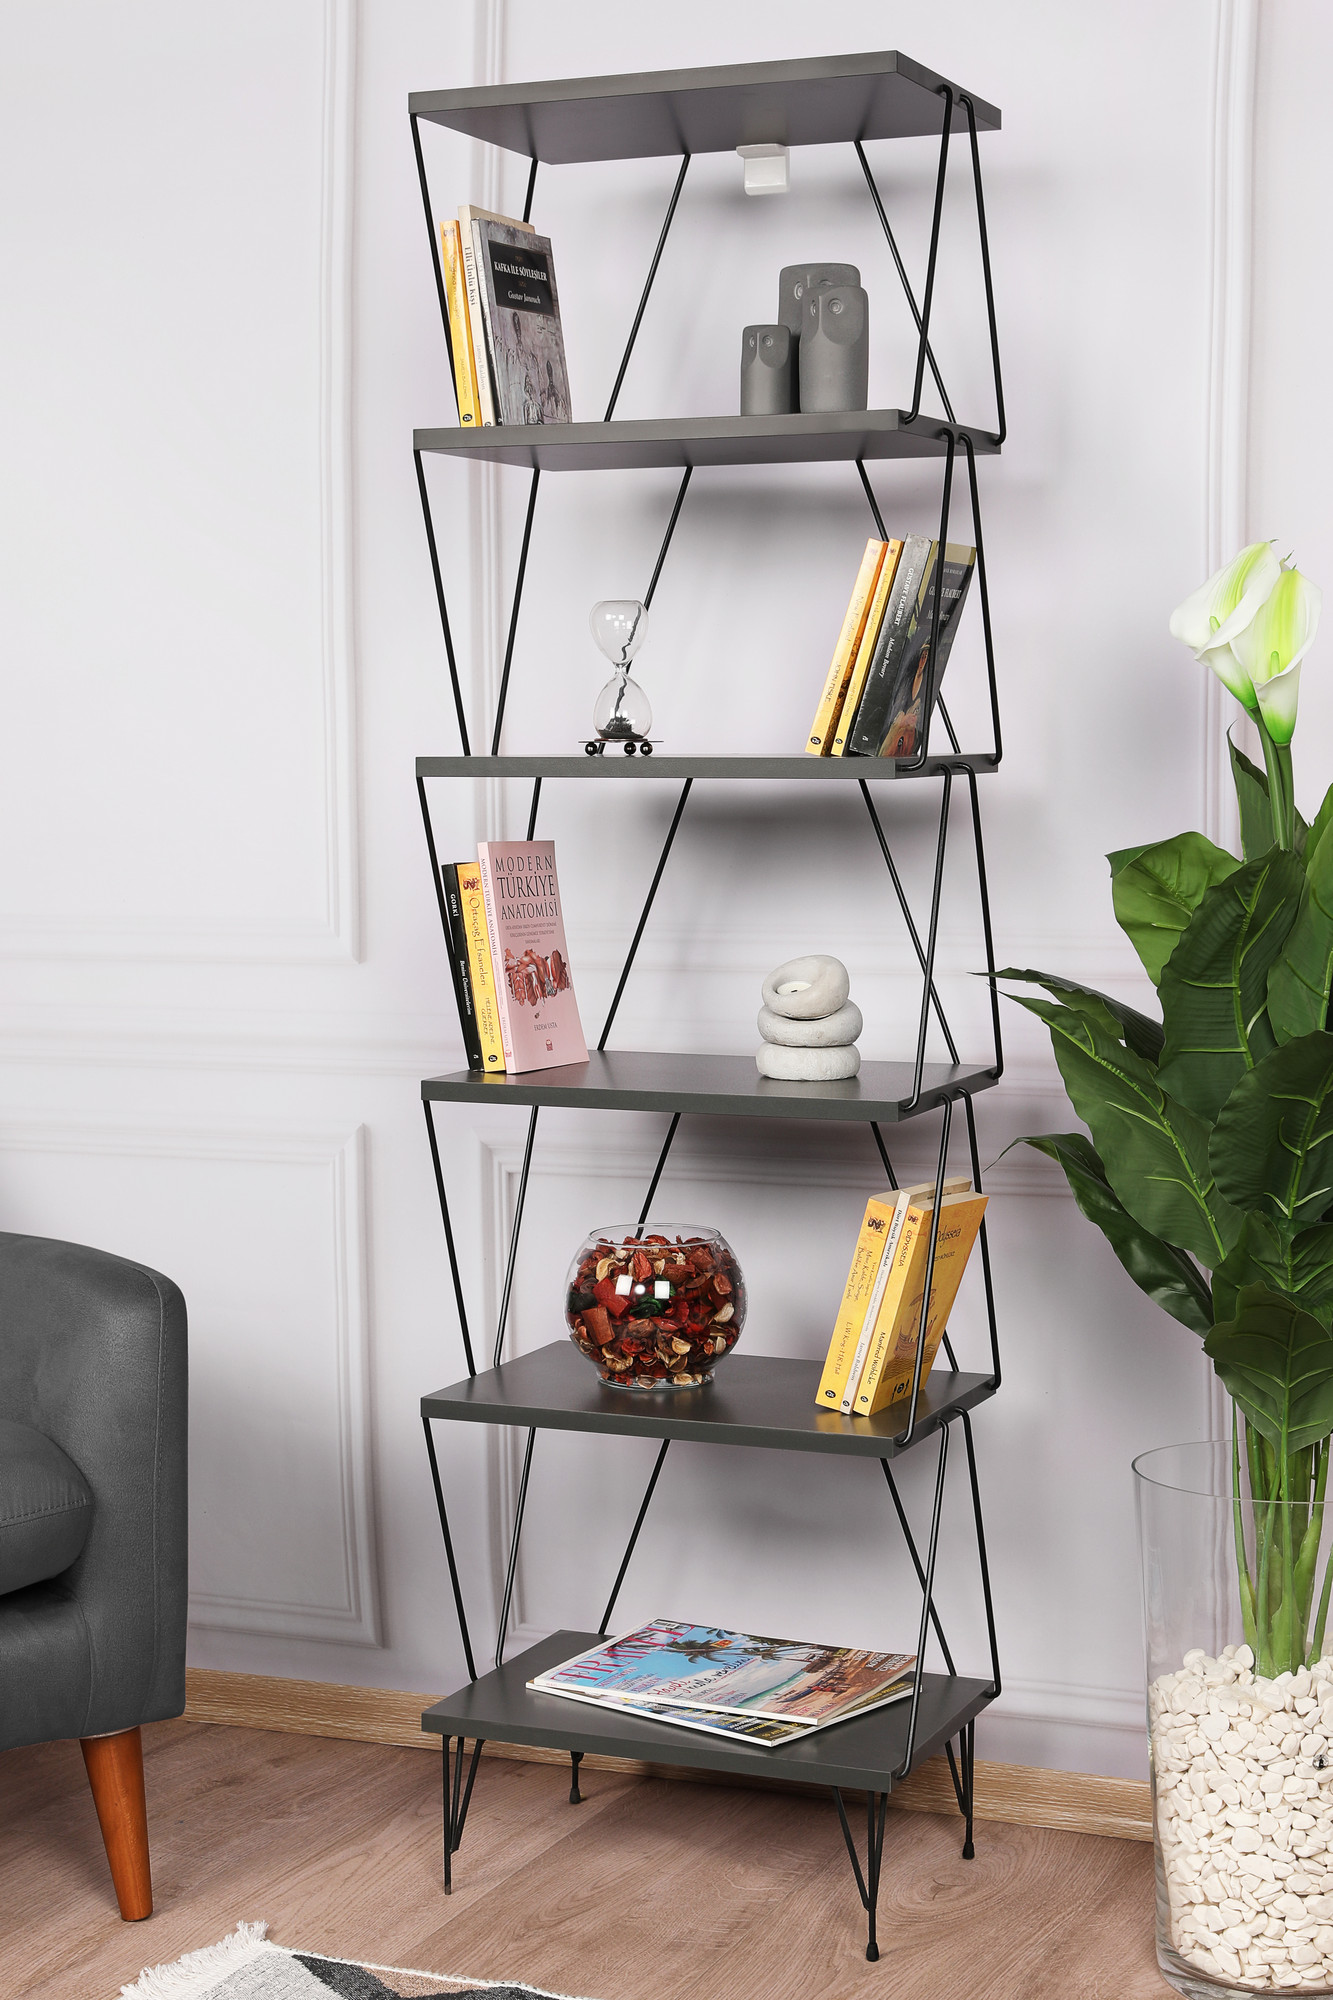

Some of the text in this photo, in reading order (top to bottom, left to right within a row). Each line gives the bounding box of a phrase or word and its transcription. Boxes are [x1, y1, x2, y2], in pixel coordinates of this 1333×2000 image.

[463, 246, 477, 305] Elli Ünlü Kişi
[494, 261, 511, 274] KAFKA
[519, 266, 548, 282] SÖYLEŞİLER
[894, 567, 915, 626] GUSTAVE FLAUBERT
[831, 661, 842, 682] JOHN
[479, 857, 489, 888] MODERN
[496, 855, 553, 872] MODERN
[497, 872, 556, 899] TÜRKİYE
[502, 899, 558, 920] ANATOMİSİ
[468, 896, 486, 985] Ortaçağ Efsaneleri
[534, 1024, 548, 1032] ERDEM
[898, 1229, 912, 1267] ODYSSEIA
[874, 1331, 886, 1360] Manfred
[551, 1625, 695, 1681] TRAVEL
